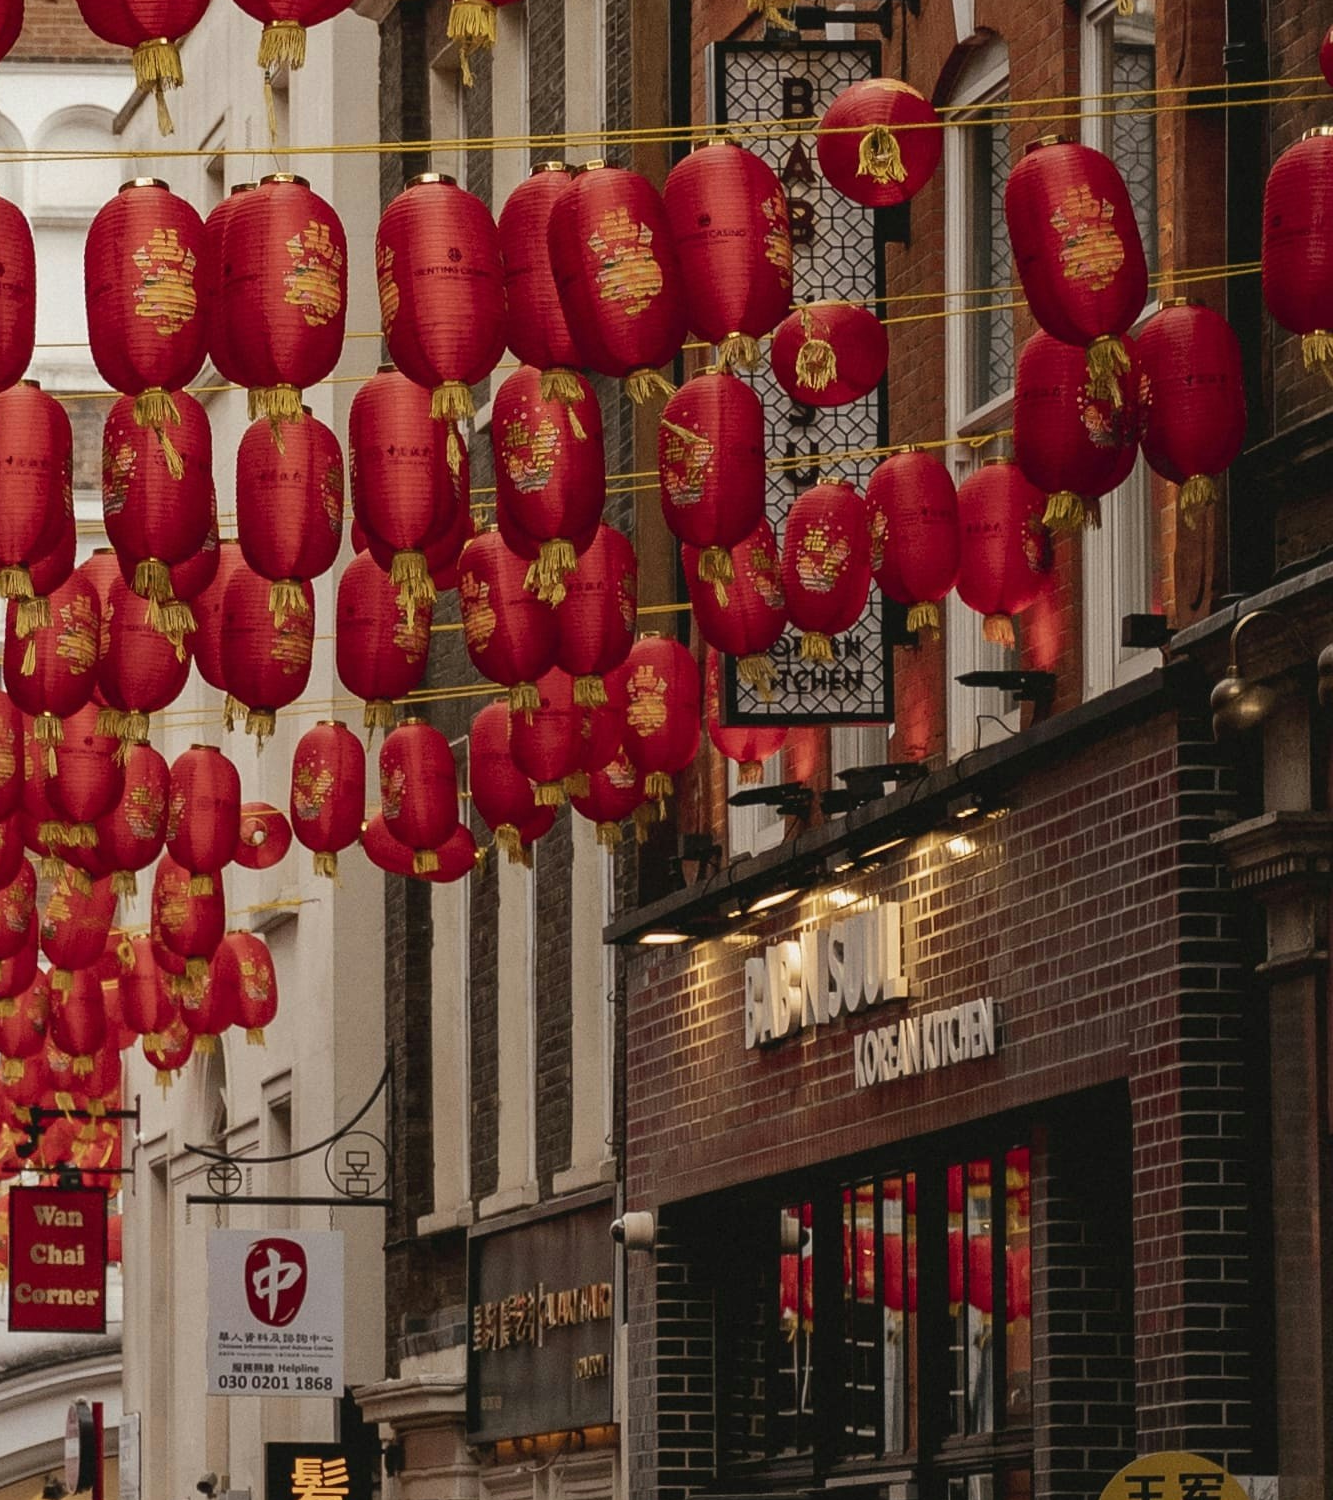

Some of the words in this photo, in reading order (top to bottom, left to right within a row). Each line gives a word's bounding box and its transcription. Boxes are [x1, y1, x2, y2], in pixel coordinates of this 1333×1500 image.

[853, 1016, 921, 1090] KOREAN
[921, 996, 995, 1073] KITCHEN
[33, 1204, 84, 1227] Wan
[30, 1243, 85, 1266] Chai
[15, 1282, 99, 1306] Corner
[278, 1363, 319, 1374] Helpline
[218, 1375, 247, 1389] 030
[251, 1376, 289, 1390] 0201
[295, 1377, 333, 1391] 1868
